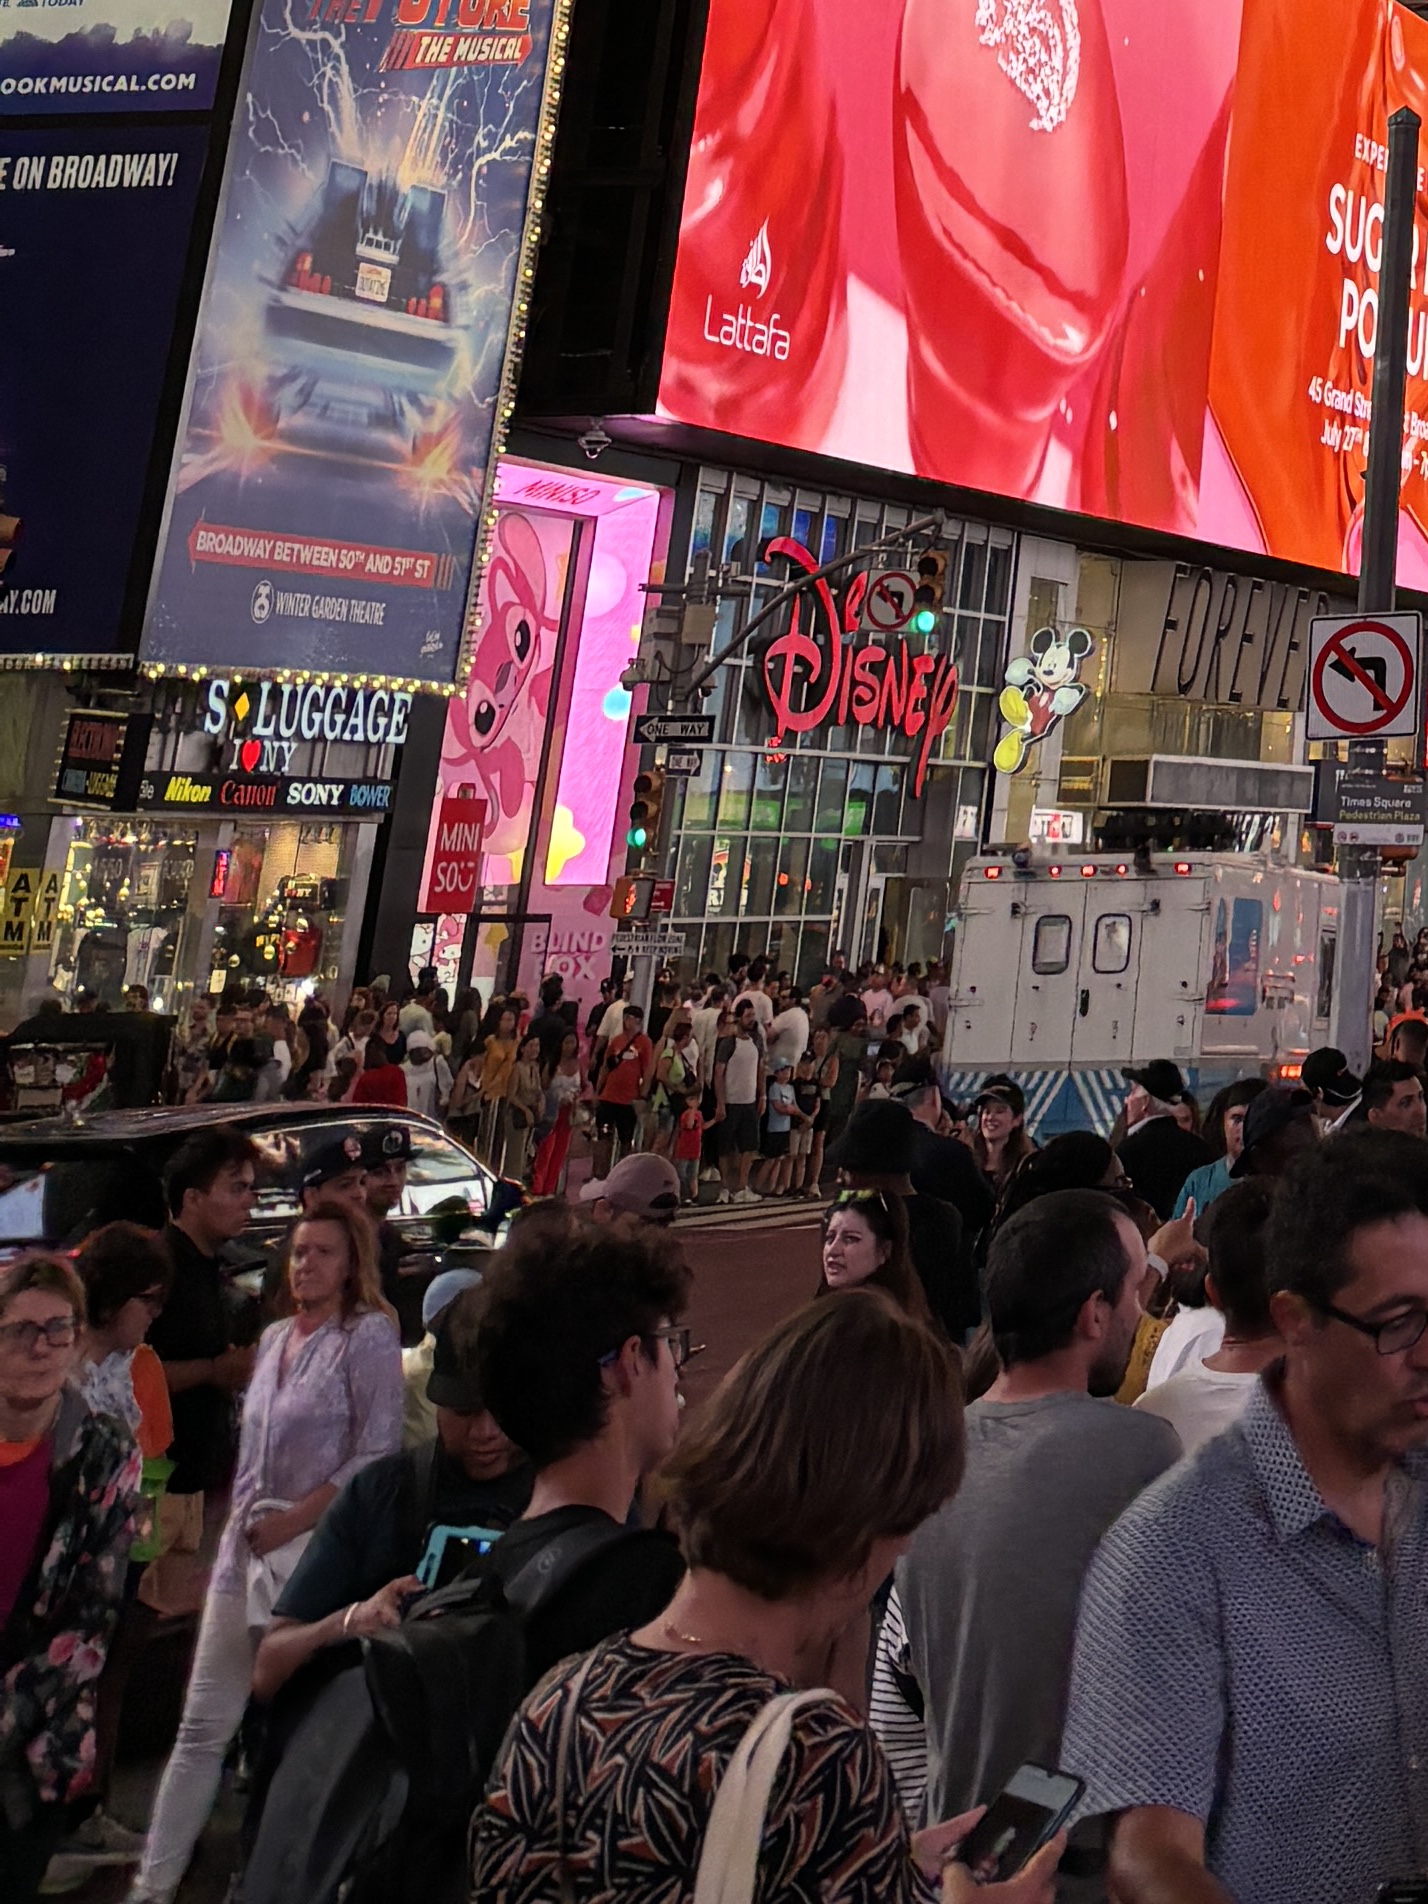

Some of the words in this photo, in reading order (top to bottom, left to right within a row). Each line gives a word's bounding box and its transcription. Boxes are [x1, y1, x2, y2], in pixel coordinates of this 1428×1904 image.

[415, 34, 453, 63] THE
[453, 35, 523, 62] MUSICAL
[13, 158, 45, 189] ON
[48, 151, 180, 189] BROADWAY!
[702, 292, 791, 363] Lattafa
[1308, 373, 1323, 402] 45
[1323, 380, 1352, 419] Grand
[1320, 418, 1341, 456] July
[196, 530, 275, 560] BROADWAY
[273, 540, 340, 570] BETWEEN
[365, 554, 392, 575] AND
[414, 560, 432, 580] ST
[275, 590, 312, 618] WINTER
[311, 594, 349, 622] GARDEN
[348, 597, 387, 627] THEATRE
[252, 680, 412, 745] LUGGAGE
[647, 722, 670, 736] ONE
[680, 723, 706, 736] WAY
[260, 740, 299, 774] NY
[164, 775, 212, 803] Nikon
[219, 779, 278, 807] Canon
[287, 781, 345, 807] SONY
[349, 783, 392, 808] BOWER
[1340, 795, 1372, 808] Times
[1373, 795, 1412, 810] Square
[1339, 809, 1393, 821] Pedestrian
[1393, 809, 1421, 821] Plaza
[440, 822, 481, 853] MINI
[4, 873, 32, 943] ATM
[37, 872, 58, 943] ATM
[530, 931, 607, 954] BLIND
